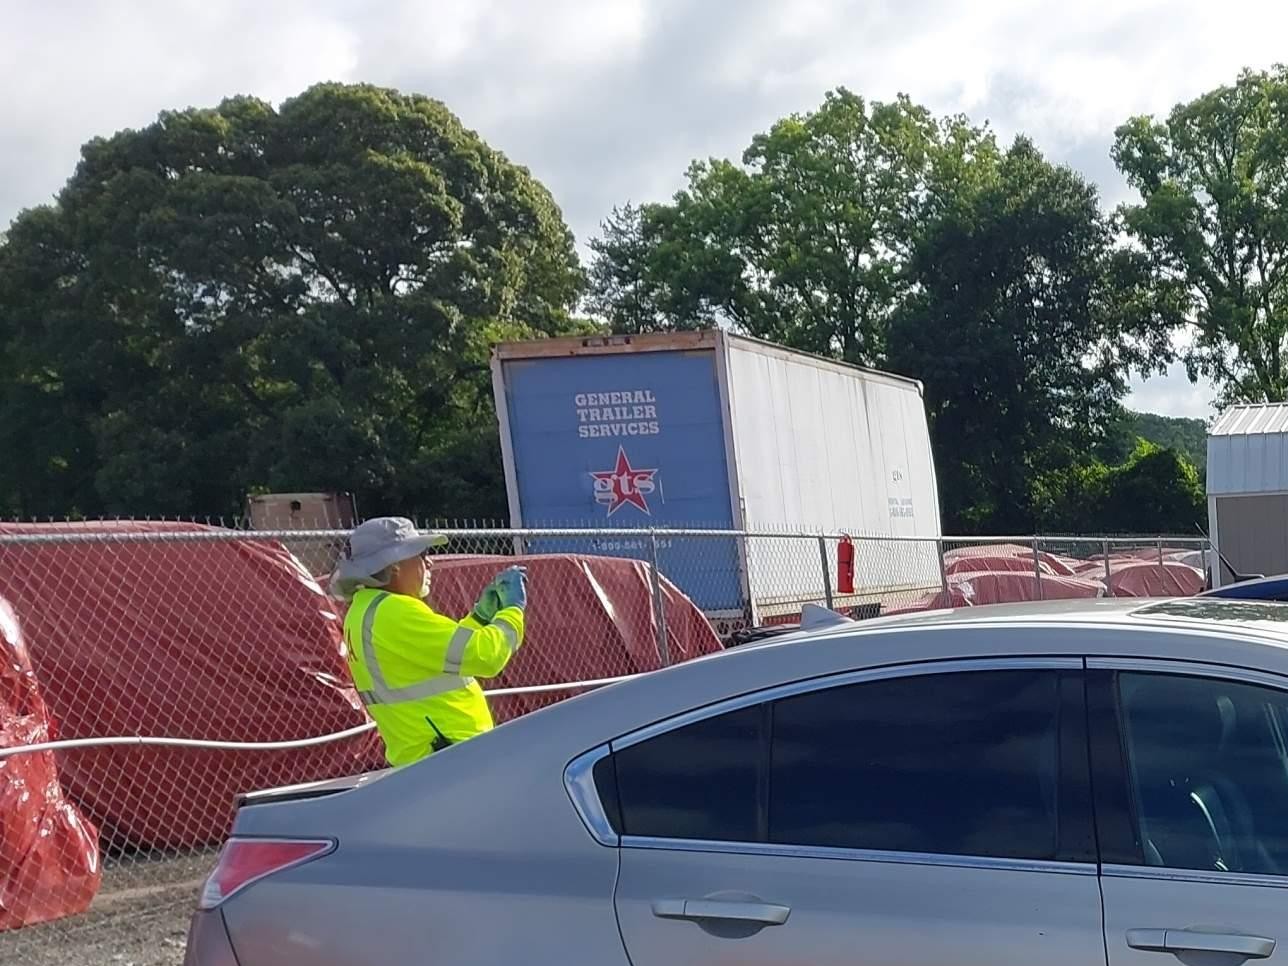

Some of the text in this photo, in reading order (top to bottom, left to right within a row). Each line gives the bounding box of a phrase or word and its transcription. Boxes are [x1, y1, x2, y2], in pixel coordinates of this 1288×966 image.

[575, 390, 656, 406] GENERAL
[577, 405, 657, 421] TRAILER
[579, 421, 659, 437] SERVICES
[593, 470, 656, 505] gts
